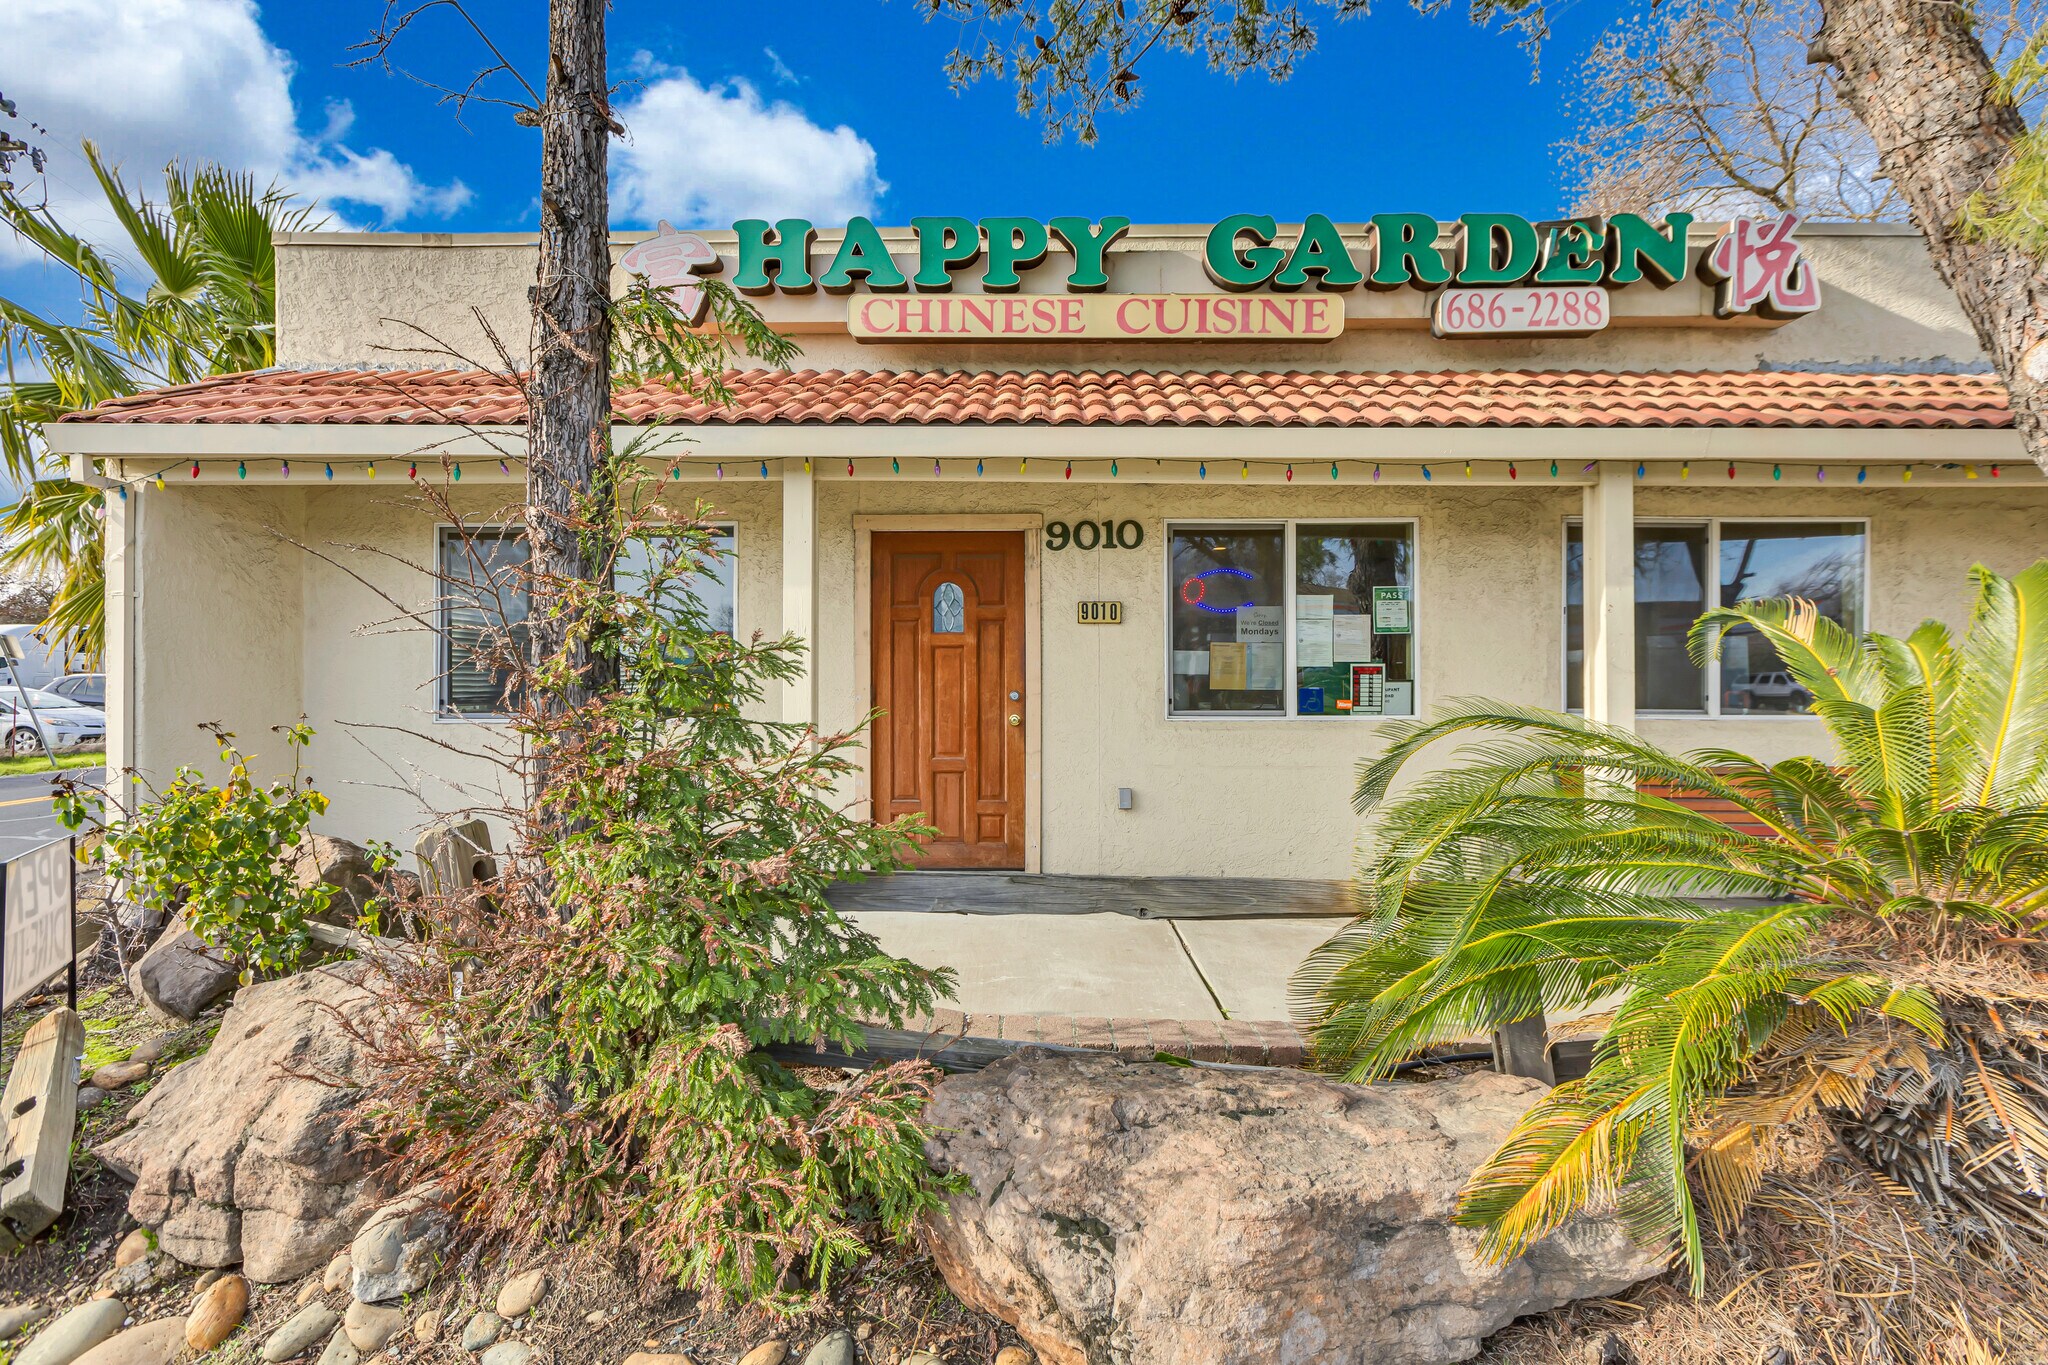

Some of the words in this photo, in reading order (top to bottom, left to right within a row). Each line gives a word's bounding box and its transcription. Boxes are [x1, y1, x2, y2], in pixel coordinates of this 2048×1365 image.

[731, 215, 1130, 291] HAPPY
[1204, 213, 1694, 289] GARDEN
[1713, 211, 1819, 309] 悦
[860, 297, 1086, 334] CHINESE
[1115, 297, 1330, 334] CUISINE
[1445, 291, 1602, 329] 686-2288
[1045, 519, 1144, 551] 9010
[1081, 602, 1118, 620] 9010
[1380, 591, 1404, 599] PASS
[1240, 627, 1279, 637] Mondays
